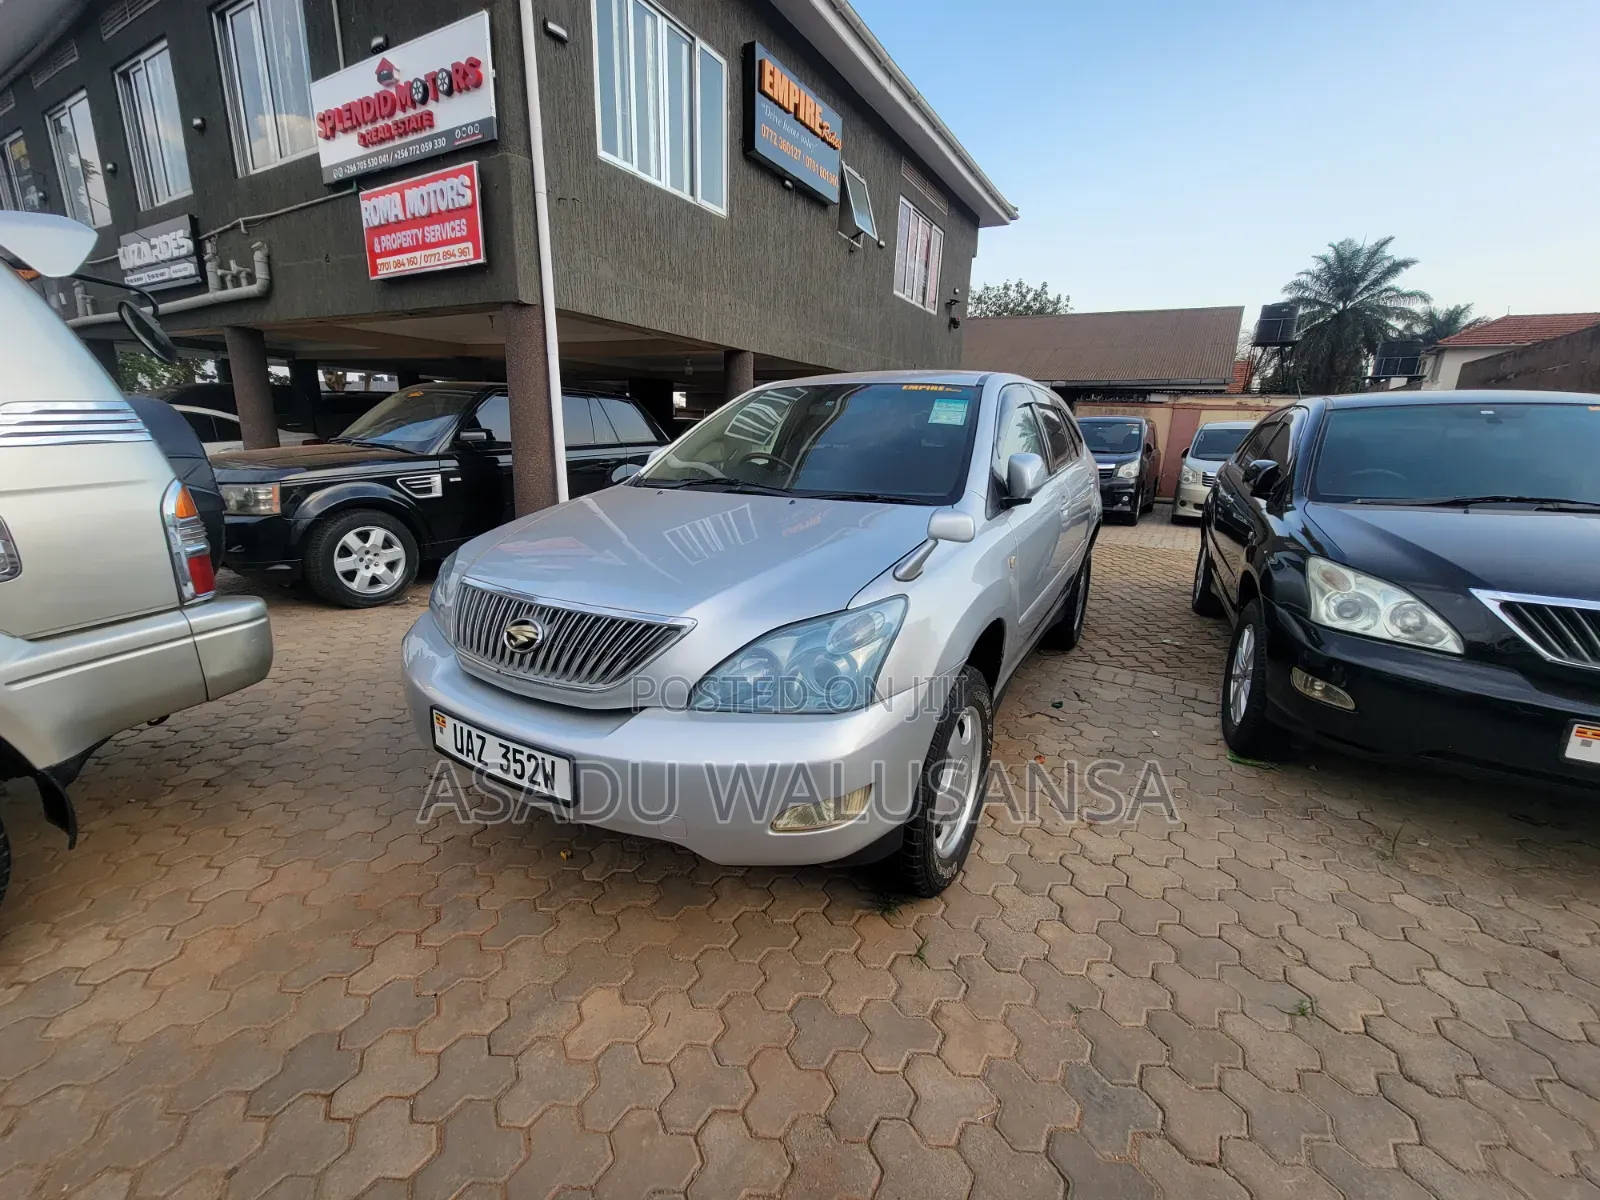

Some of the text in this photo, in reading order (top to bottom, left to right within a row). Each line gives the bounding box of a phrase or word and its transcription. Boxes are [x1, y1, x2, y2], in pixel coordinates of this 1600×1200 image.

[315, 56, 484, 140] SPLENDID MOTORS
[760, 58, 842, 150] EMPIRE Rides
[365, 123, 395, 146] REAL
[391, 110, 435, 138] ESTATE
[761, 123, 778, 147] 0772
[344, 164, 357, 175] +256
[356, 161, 367, 171] 705
[367, 158, 378, 168] 530
[378, 154, 389, 165] 041
[394, 148, 408, 160] +256
[408, 145, 420, 157] 772
[420, 141, 433, 154] 059
[433, 137, 446, 150] 330
[361, 174, 473, 229] ROMA MOTORS
[373, 218, 467, 253] & PROPERTY SERVICES
[377, 261, 392, 272] 0701
[392, 259, 406, 270] 084
[406, 256, 418, 267] 160
[423, 251, 442, 264] 0772
[442, 249, 457, 260] 894
[457, 246, 471, 258] 961
[901, 384, 946, 392] EMPIRE
[453, 722, 556, 791] UAZ 352W
